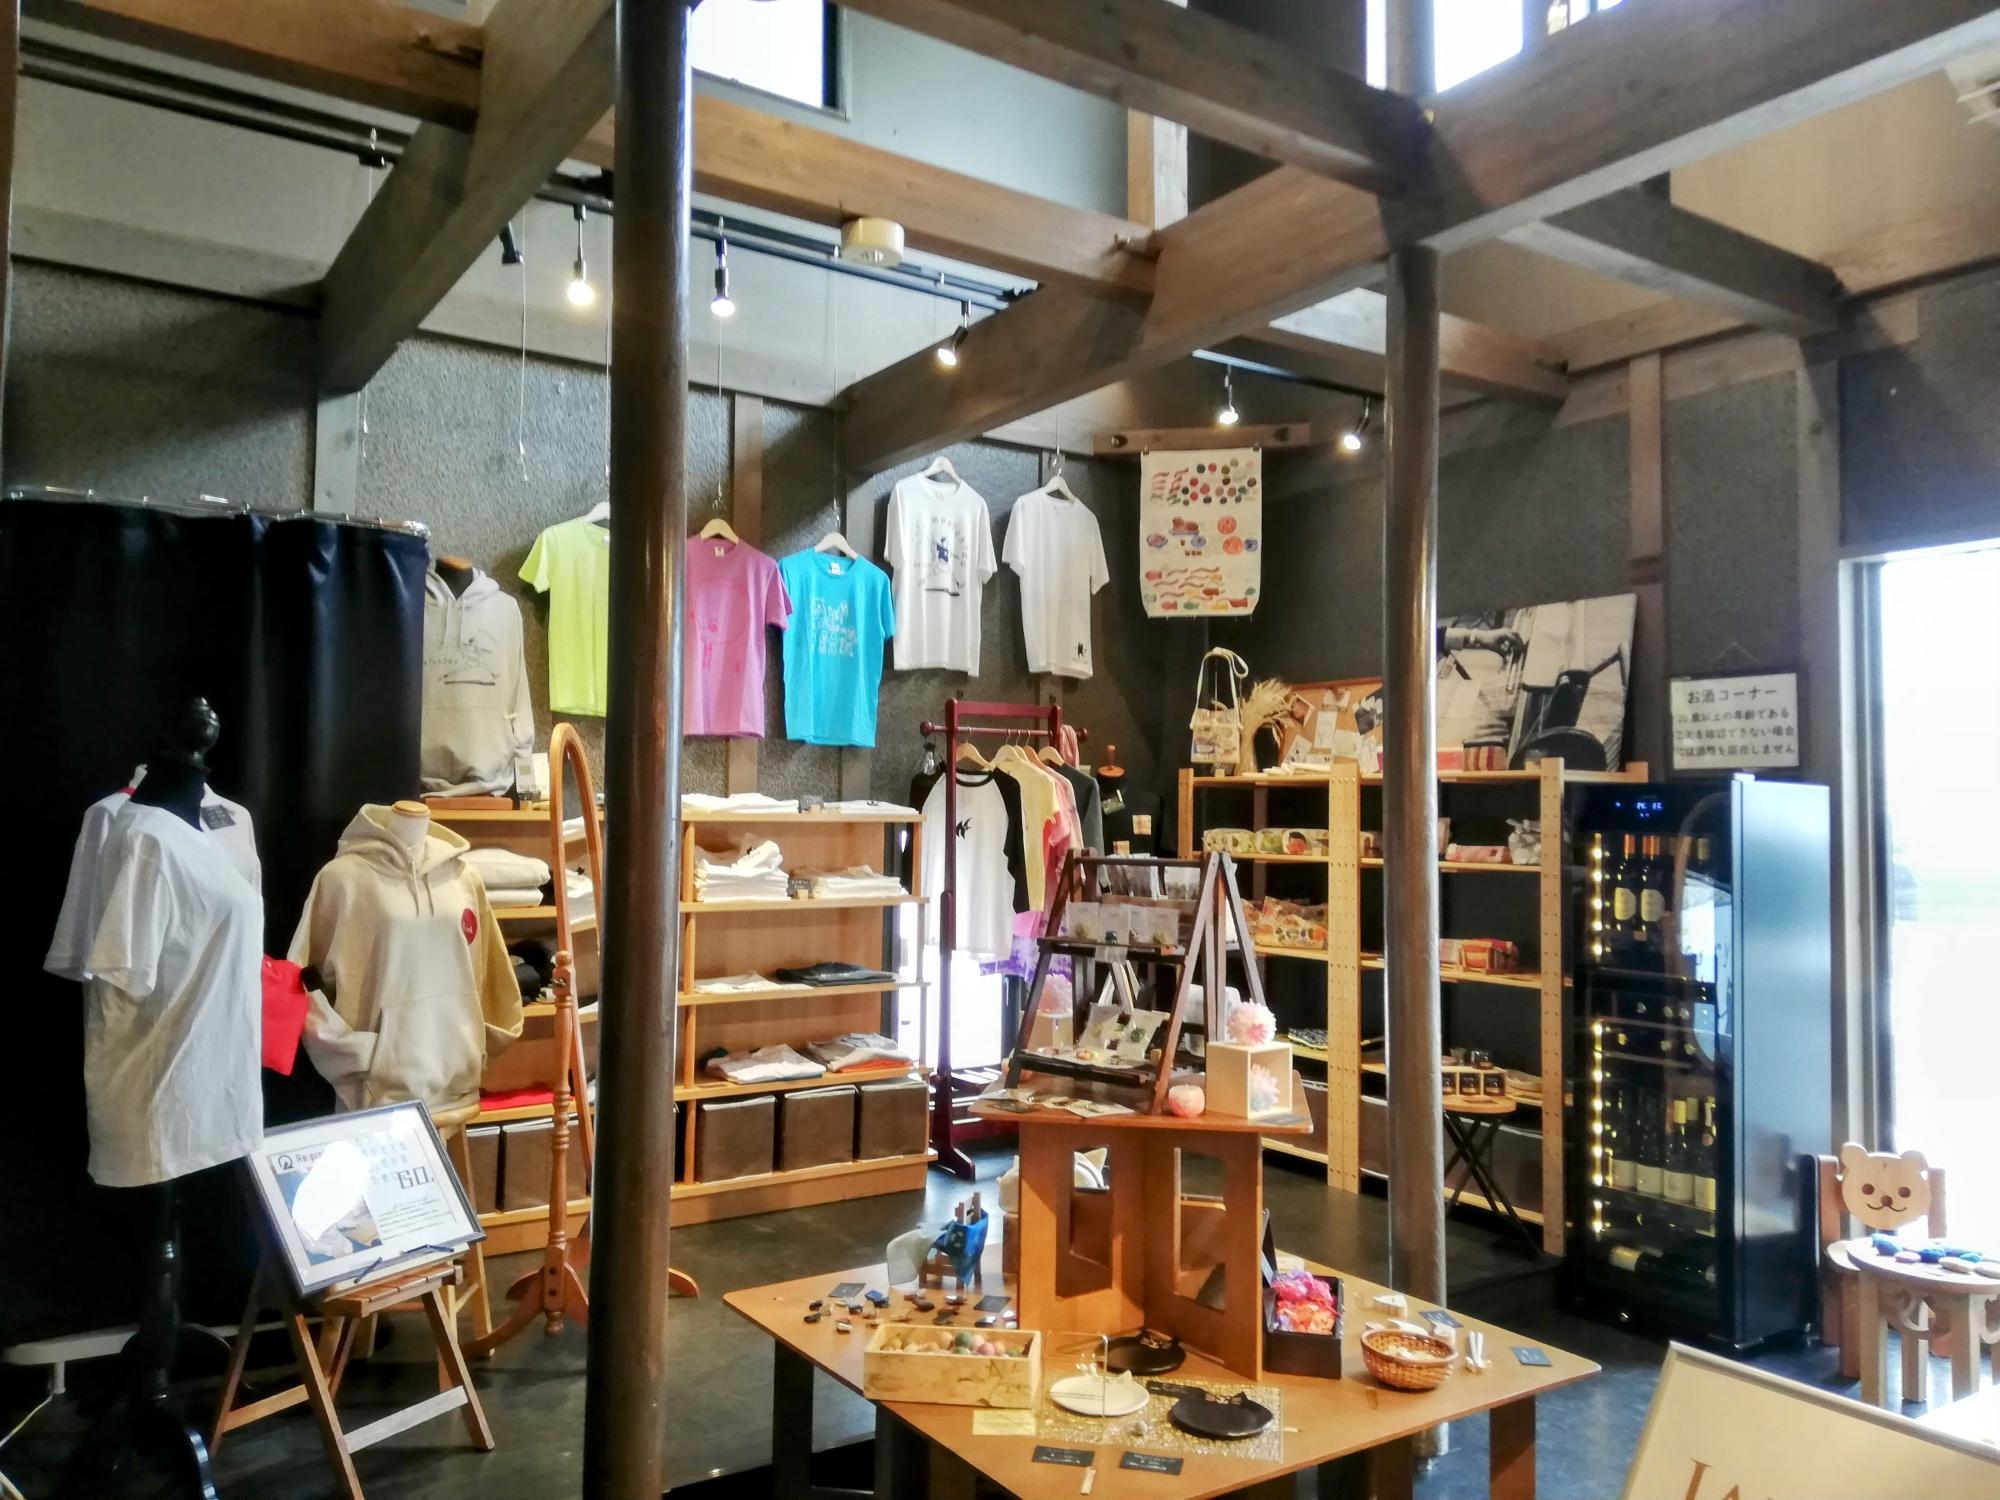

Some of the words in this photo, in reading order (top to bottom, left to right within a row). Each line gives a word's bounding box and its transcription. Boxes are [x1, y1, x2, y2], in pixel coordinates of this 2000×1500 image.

[1687, 685, 1778, 704] お酒コーナー
